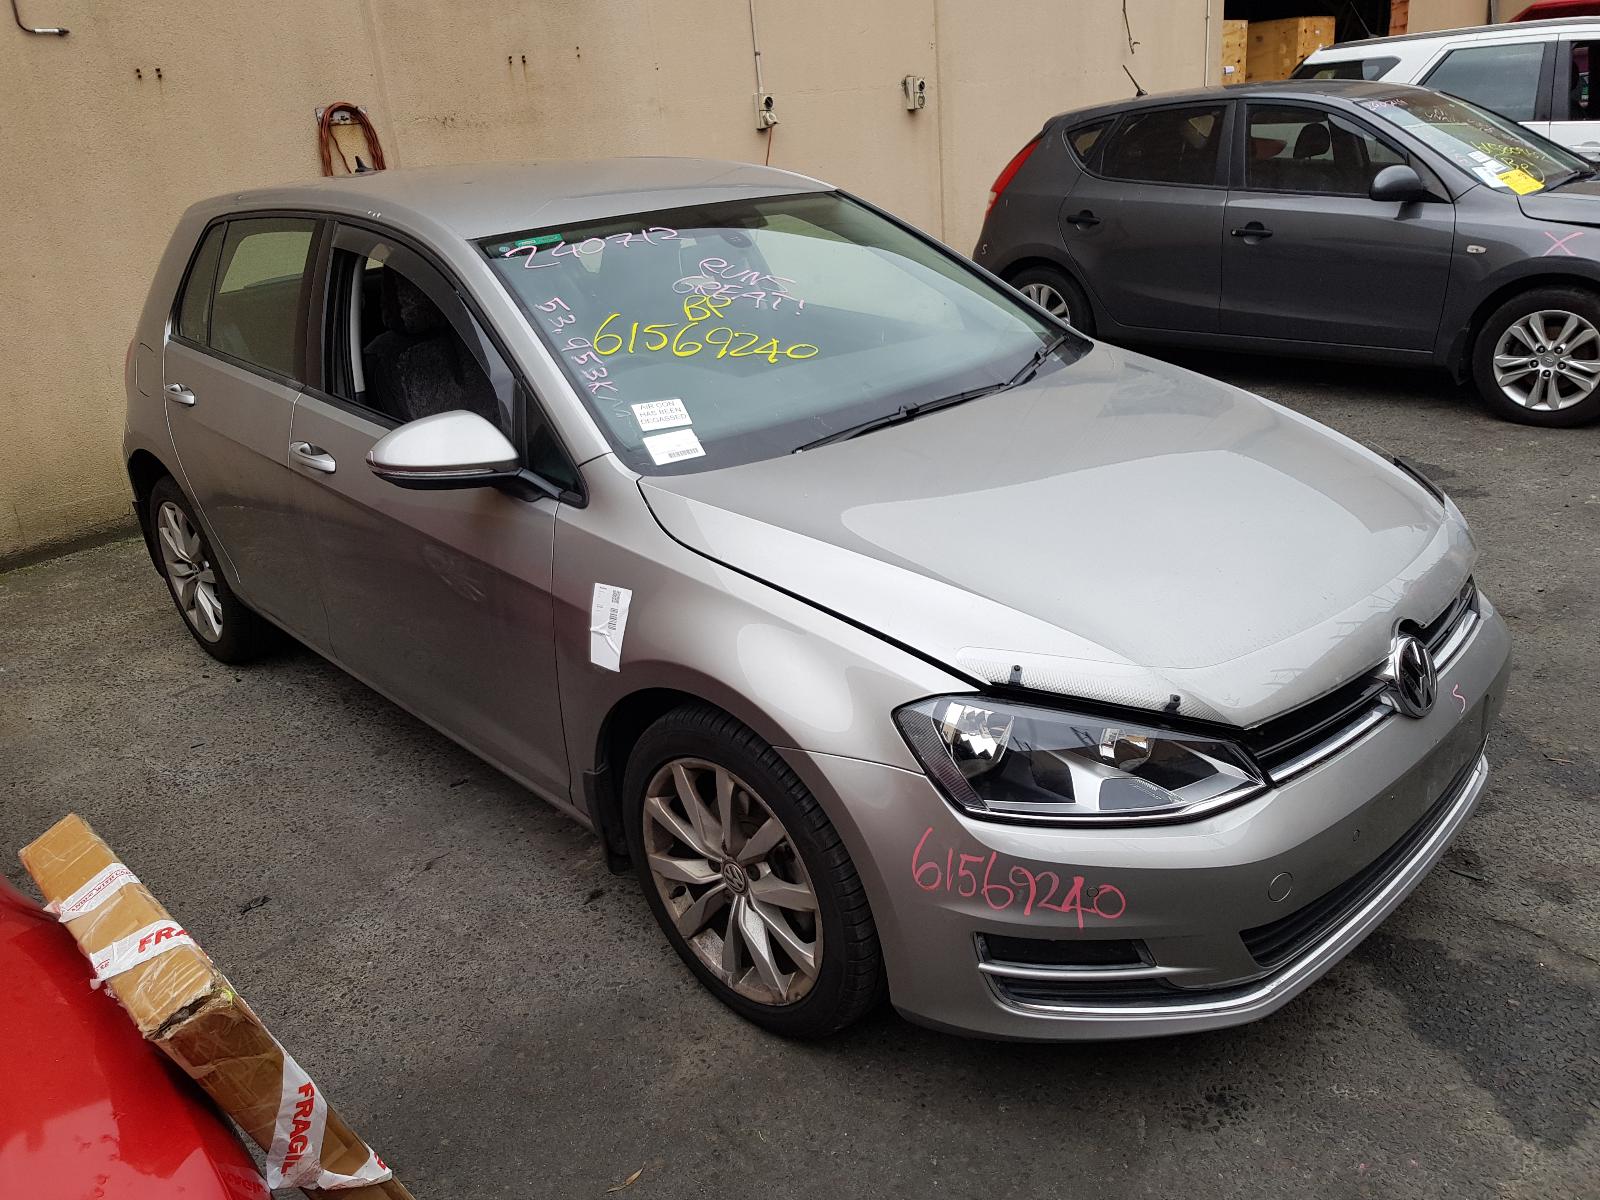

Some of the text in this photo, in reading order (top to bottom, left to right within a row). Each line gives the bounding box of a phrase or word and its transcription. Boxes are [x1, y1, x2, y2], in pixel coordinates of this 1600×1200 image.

[594, 312, 818, 363] 61569240
[911, 827, 1127, 929] 61569240
[281, 1081, 315, 1177] FRAGIL
